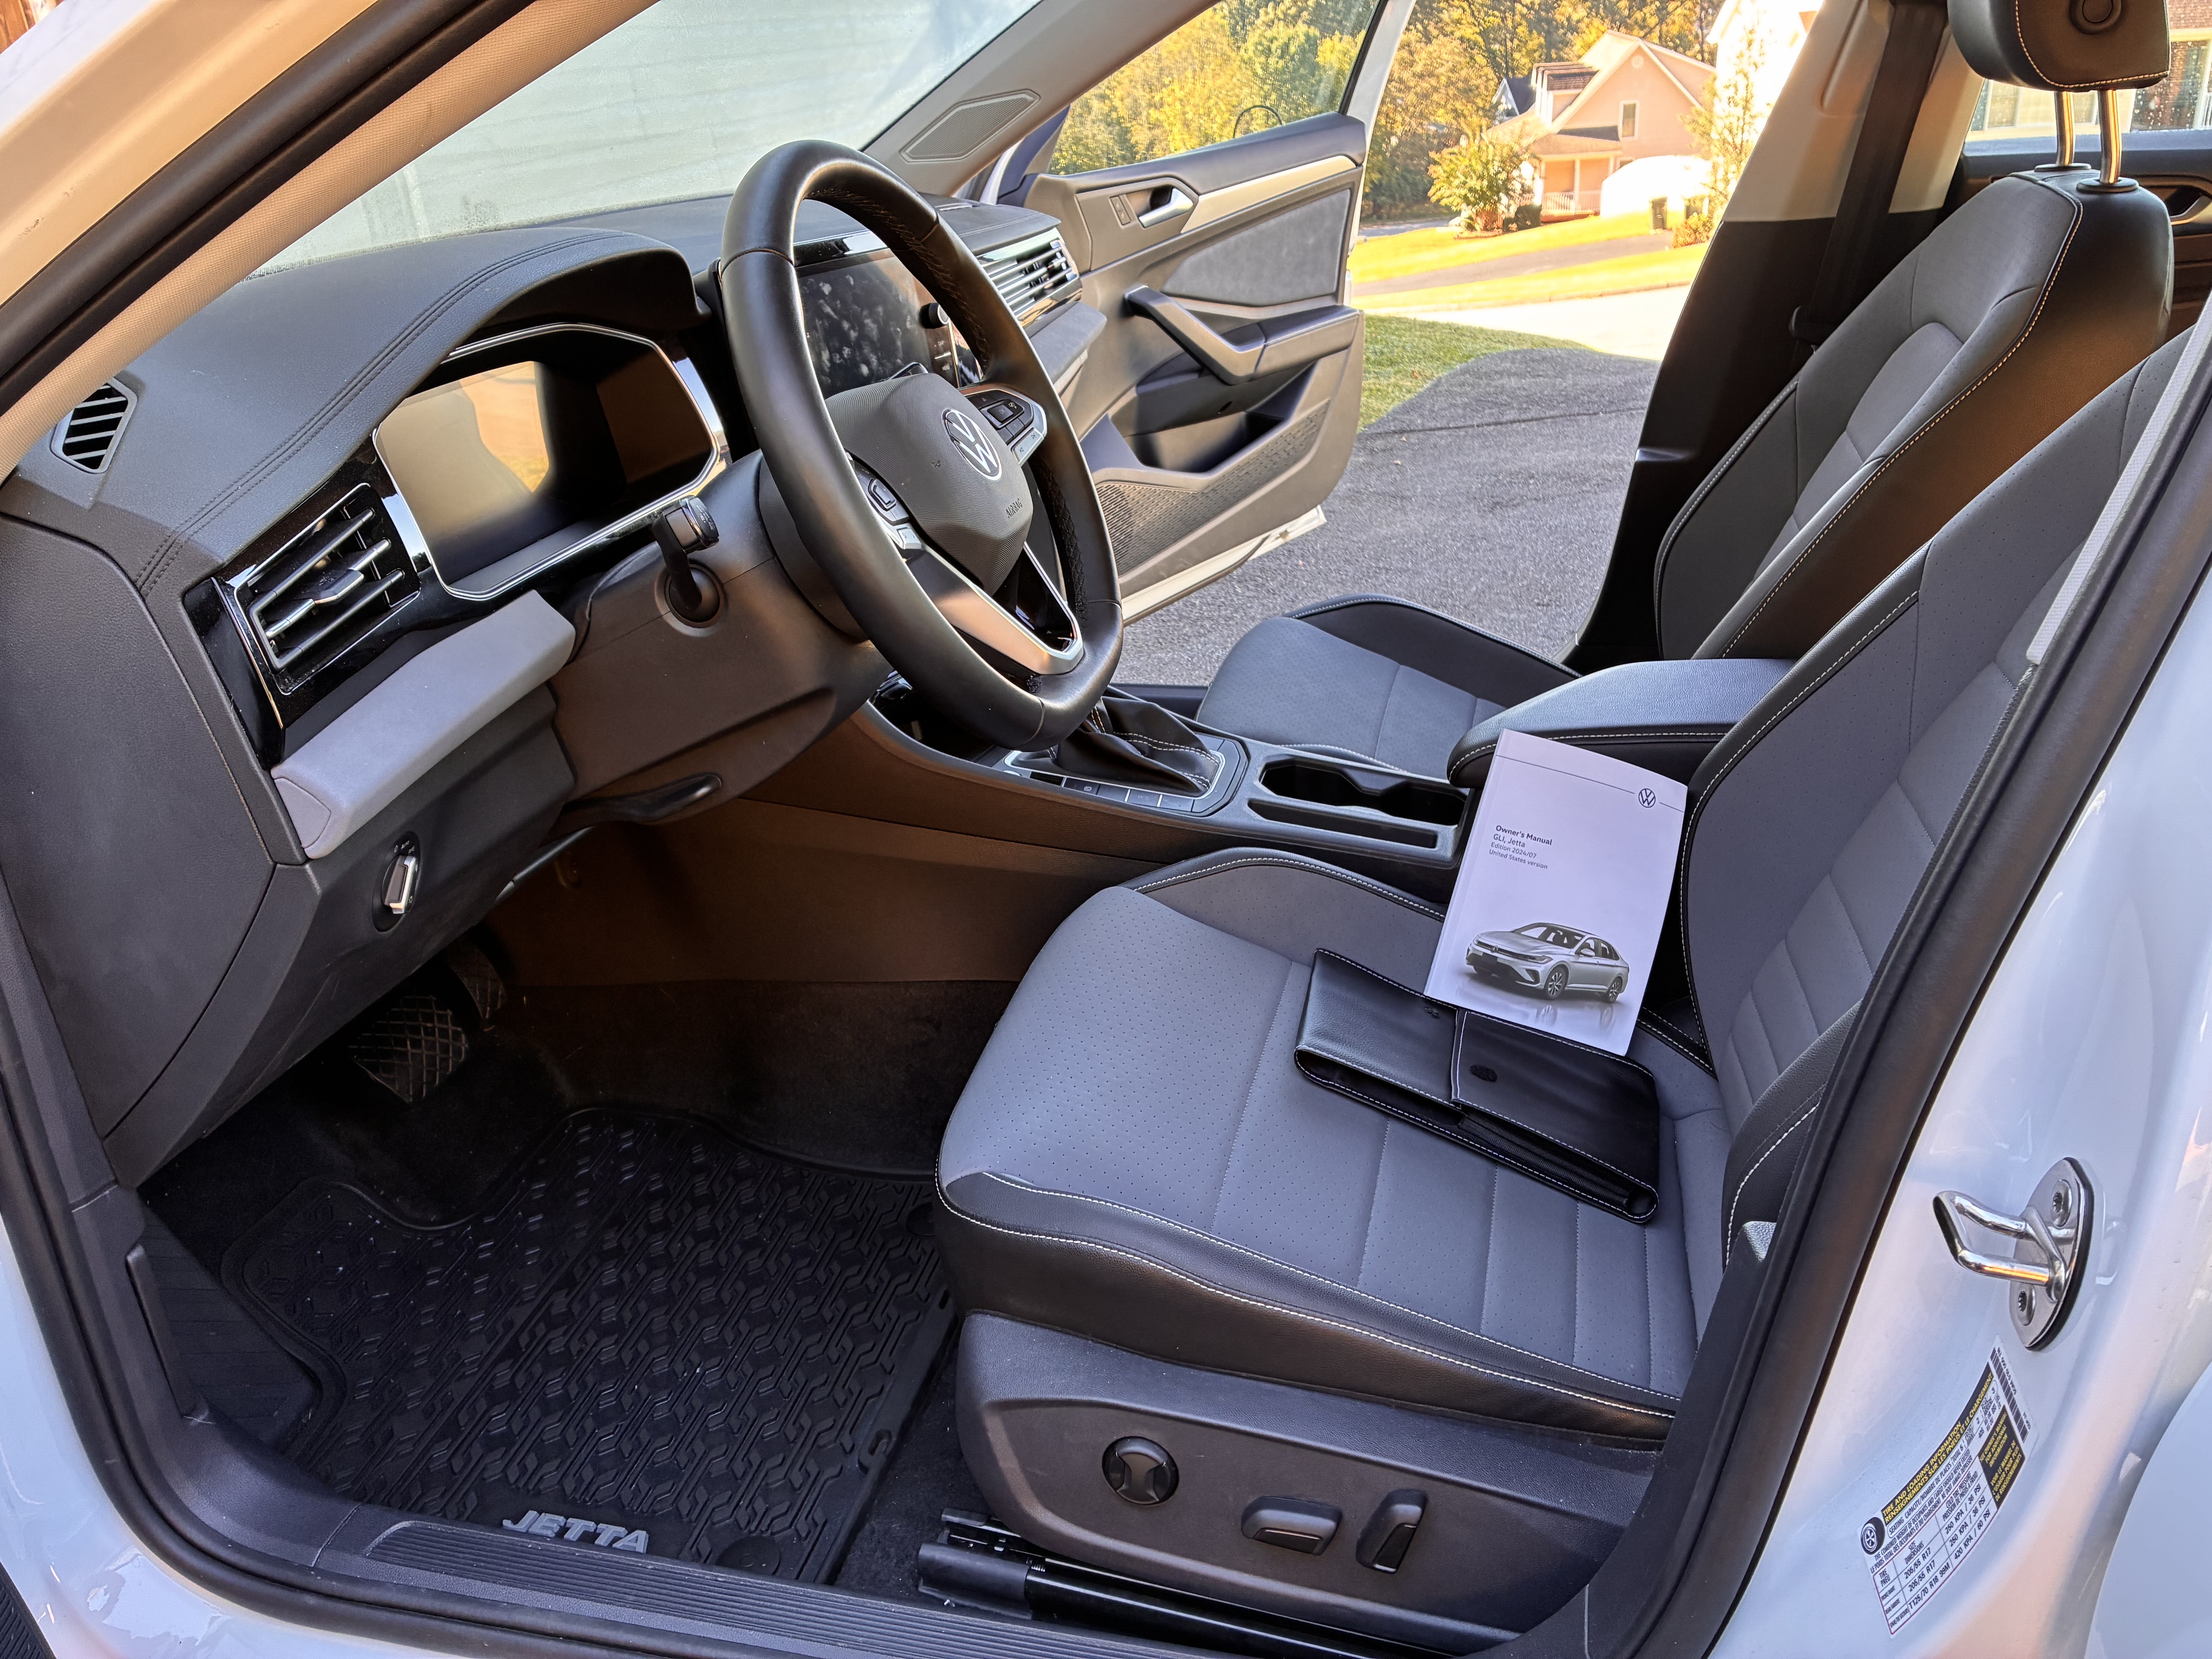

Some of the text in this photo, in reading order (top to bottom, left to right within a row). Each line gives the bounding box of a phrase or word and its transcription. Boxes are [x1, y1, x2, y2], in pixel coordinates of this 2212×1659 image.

[1006, 498, 1022, 519] AIRBAG
[1491, 842, 1537, 859] Edition 2024/07
[1493, 834, 1525, 848] GLI, Jetta
[1496, 825, 1553, 845] Owner's Manual
[1489, 849, 1547, 869] United States version
[1885, 1372, 1992, 1523] RENSEIGNEMENTS SUR LES PNEUS ET LE CHARGEMENT
[1984, 1432, 1997, 1454] OWNER'S
[1996, 1412, 2007, 1433] MANUAL
[1991, 1424, 2007, 1453] ADDITIONAL
[1989, 1433, 2008, 1467] INFORMATION
[1990, 1473, 1999, 1486] VOIR
[2001, 1448, 2013, 1468] MANUEL
[2011, 1440, 2016, 1449] DE
[2005, 1458, 2013, 1473] POUR
[1883, 1421, 1961, 1516] TIRE AND LOADING INFORMATION
[1995, 1453, 2021, 1501] DE RENSEIGNEMENTS
[1881, 1538, 1897, 1556] COMBINED
[1897, 1526, 1909, 1541] WEIGHT
[1908, 1522, 1913, 1530] OF
[1912, 1505, 1928, 1525] OCCUPANTS
[1933, 1485, 1944, 1502] CARGO
[1943, 1472, 1954, 1489] SHOULD
[1953, 1461, 1962, 1475] NEVER
[1889, 1516, 1904, 1535] SEATING
[1936, 1476, 1941, 1485] DE
[1941, 1462, 1952, 1479] PLACES
[1942, 1502, 1956, 1522] PRESSION
[1945, 1521, 1954, 1535] 250
[1954, 1509, 1964, 1523] KPA
[1968, 1494, 1974, 1504] 36
[1946, 1497, 1954, 1508] COLD
[502, 1510, 649, 1553] JETTA
[1870, 1565, 1875, 1573] LE
[1874, 1558, 1884, 1570] POIDS
[1884, 1550, 1894, 1563] TOTAL
[1899, 1528, 1916, 1548] OCCUPANTS
[1915, 1523, 1920, 1532] ET
[1920, 1517, 1925, 1526] DU
[1923, 1499, 1941, 1522] CHARGEMENT
[1949, 1534, 1958, 1547] 250
[1959, 1521, 1968, 1535] KPA
[1973, 1506, 1978, 1517] 36
[1954, 1547, 1963, 1560] 420
[1963, 1535, 1973, 1549] KPA
[1977, 1520, 1983, 1530] 60
[1904, 1541, 1924, 1565] DIMENSIONS
[1908, 1540, 1917, 1551] SIZE
[1879, 1568, 1887, 1579] TIRE
[1904, 1547, 1931, 1579] 205/55 R17
[1908, 1559, 1935, 1592] 205/55 R17
[1880, 1576, 1891, 1587] PNEU
[1908, 1562, 1950, 1609] T125/70 R18 99M
